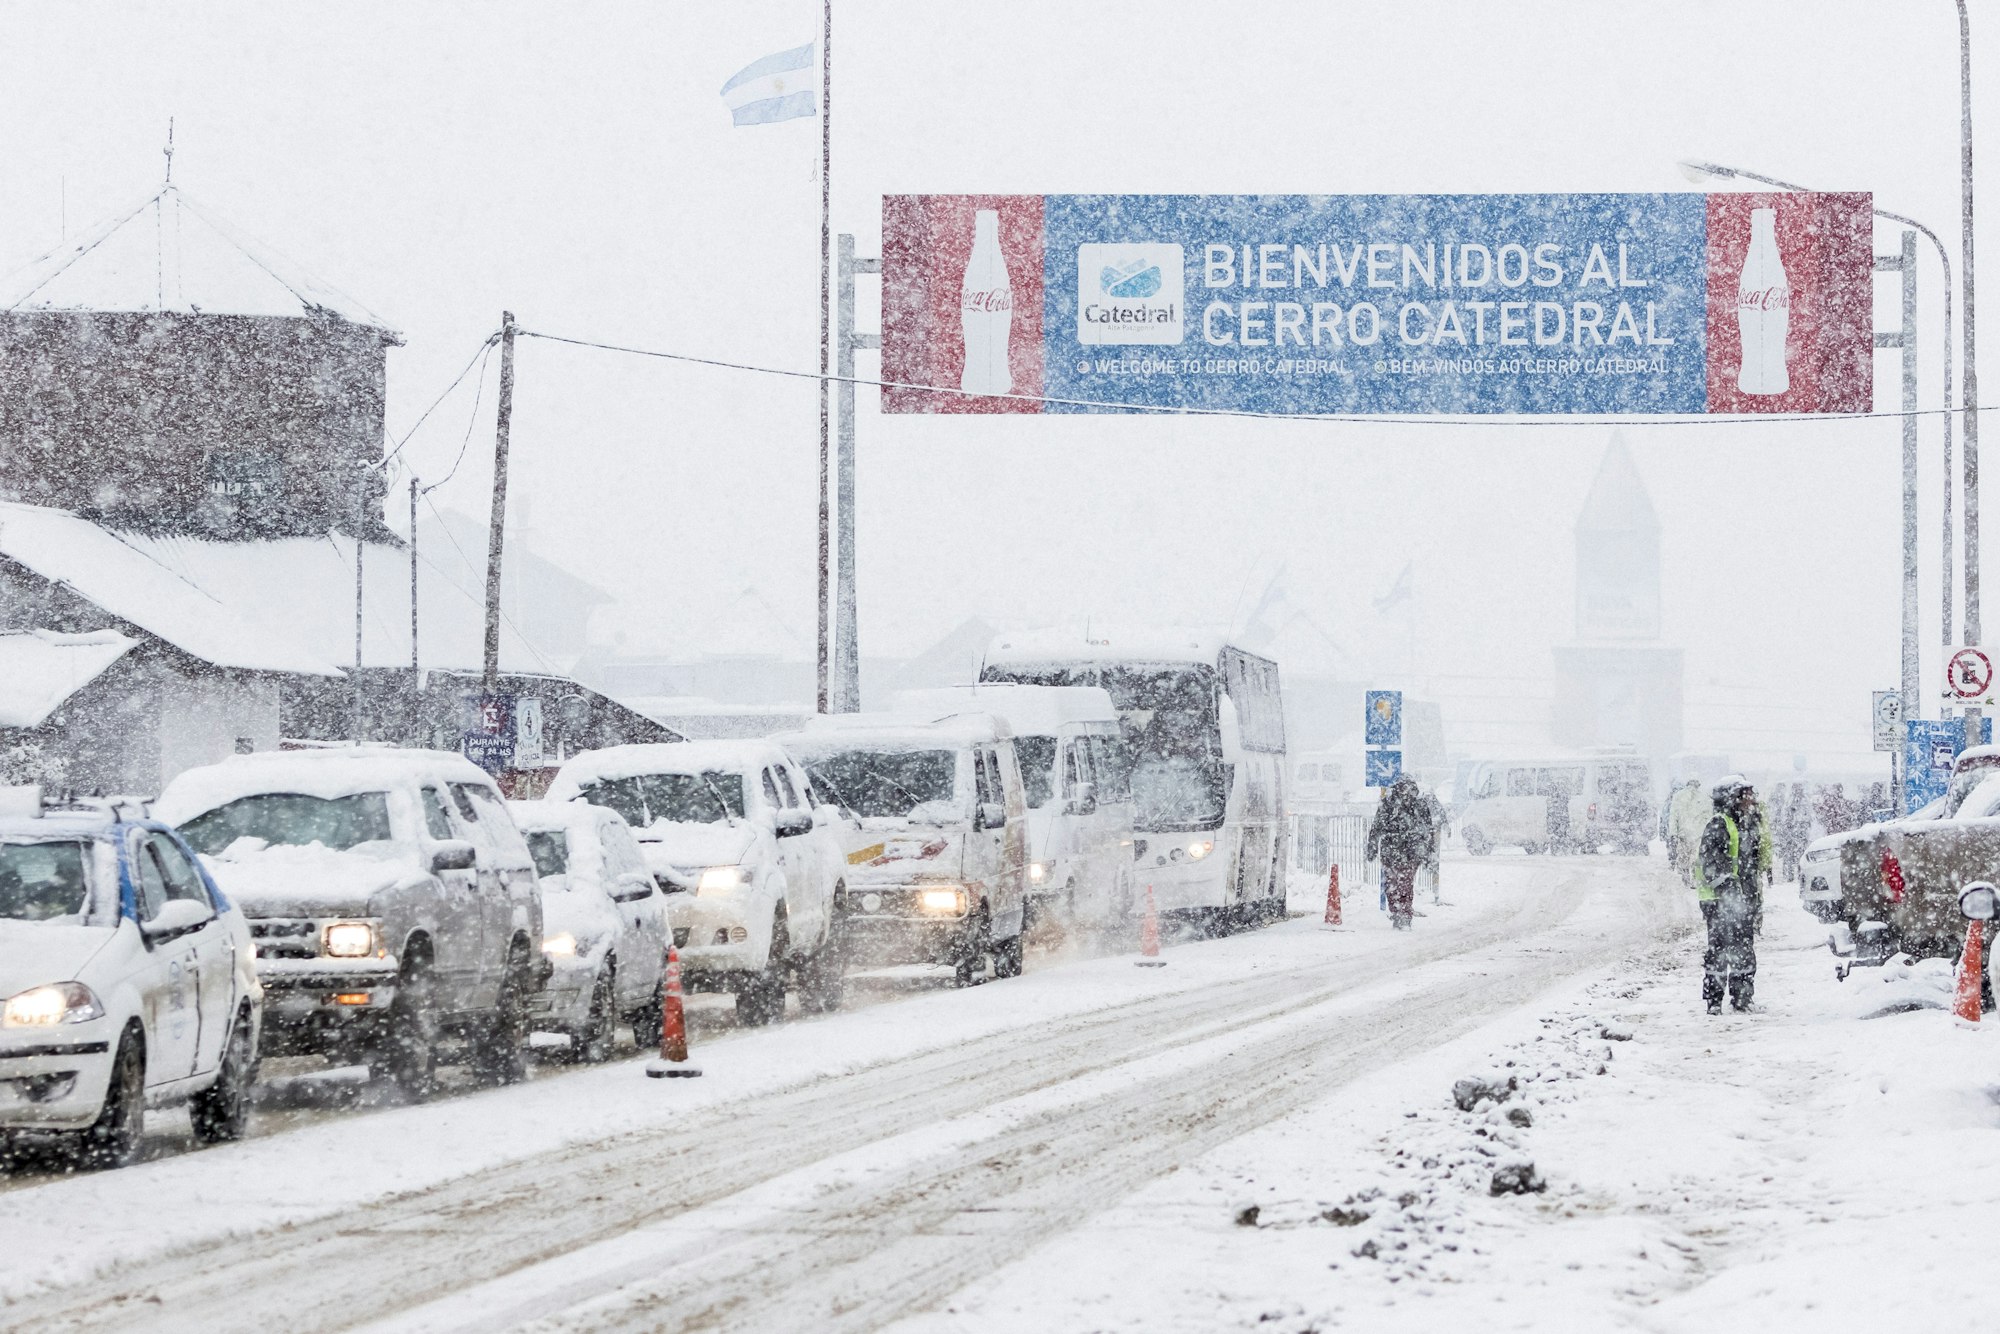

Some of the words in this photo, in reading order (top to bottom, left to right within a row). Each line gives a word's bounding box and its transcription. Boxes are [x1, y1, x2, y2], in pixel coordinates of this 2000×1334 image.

[1204, 243, 1564, 289] BIENVENIDOS
[1578, 243, 1648, 289] AL
[1085, 303, 1177, 324] Catedral
[1203, 301, 1381, 347] CERRO
[1398, 301, 1676, 347] CATEDRAL
[1095, 359, 1177, 375] WELCOME
[1180, 359, 1201, 375] TO
[1205, 359, 1261, 375] CERRO
[1265, 359, 1351, 375] CATEDRAL
[1499, 359, 1521, 374] AO
[1524, 359, 1580, 374] CERRO
[1585, 359, 1671, 374] CATEDRAL
[469, 739, 511, 747] DURANTE
